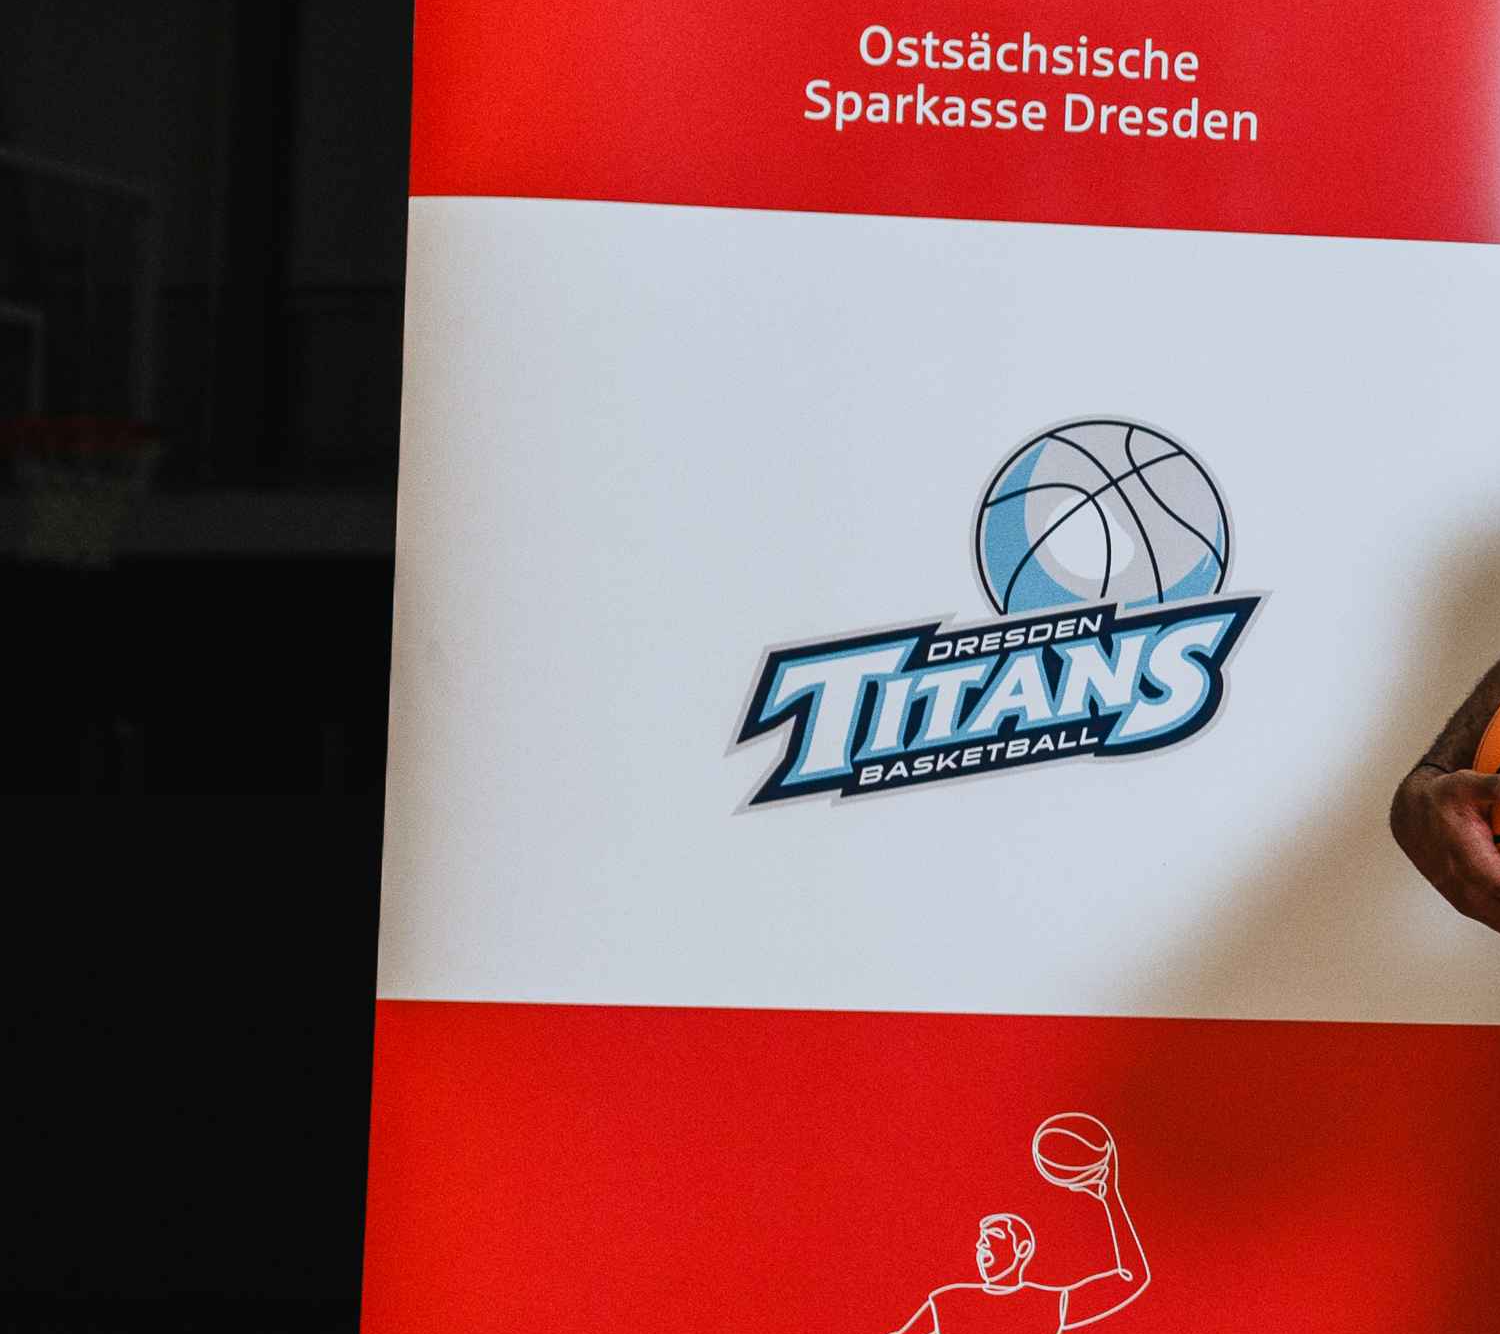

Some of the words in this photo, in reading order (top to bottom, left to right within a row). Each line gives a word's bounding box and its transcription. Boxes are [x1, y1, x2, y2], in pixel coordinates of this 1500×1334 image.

[859, 24, 1199, 83] Ostsächsische
[803, 79, 1048, 132] Sparkasse
[1064, 93, 1259, 142] Dresden
[926, 614, 1103, 663] DRESDEN
[760, 612, 1236, 785] TITANS
[858, 726, 1099, 787] BASKETBALL
